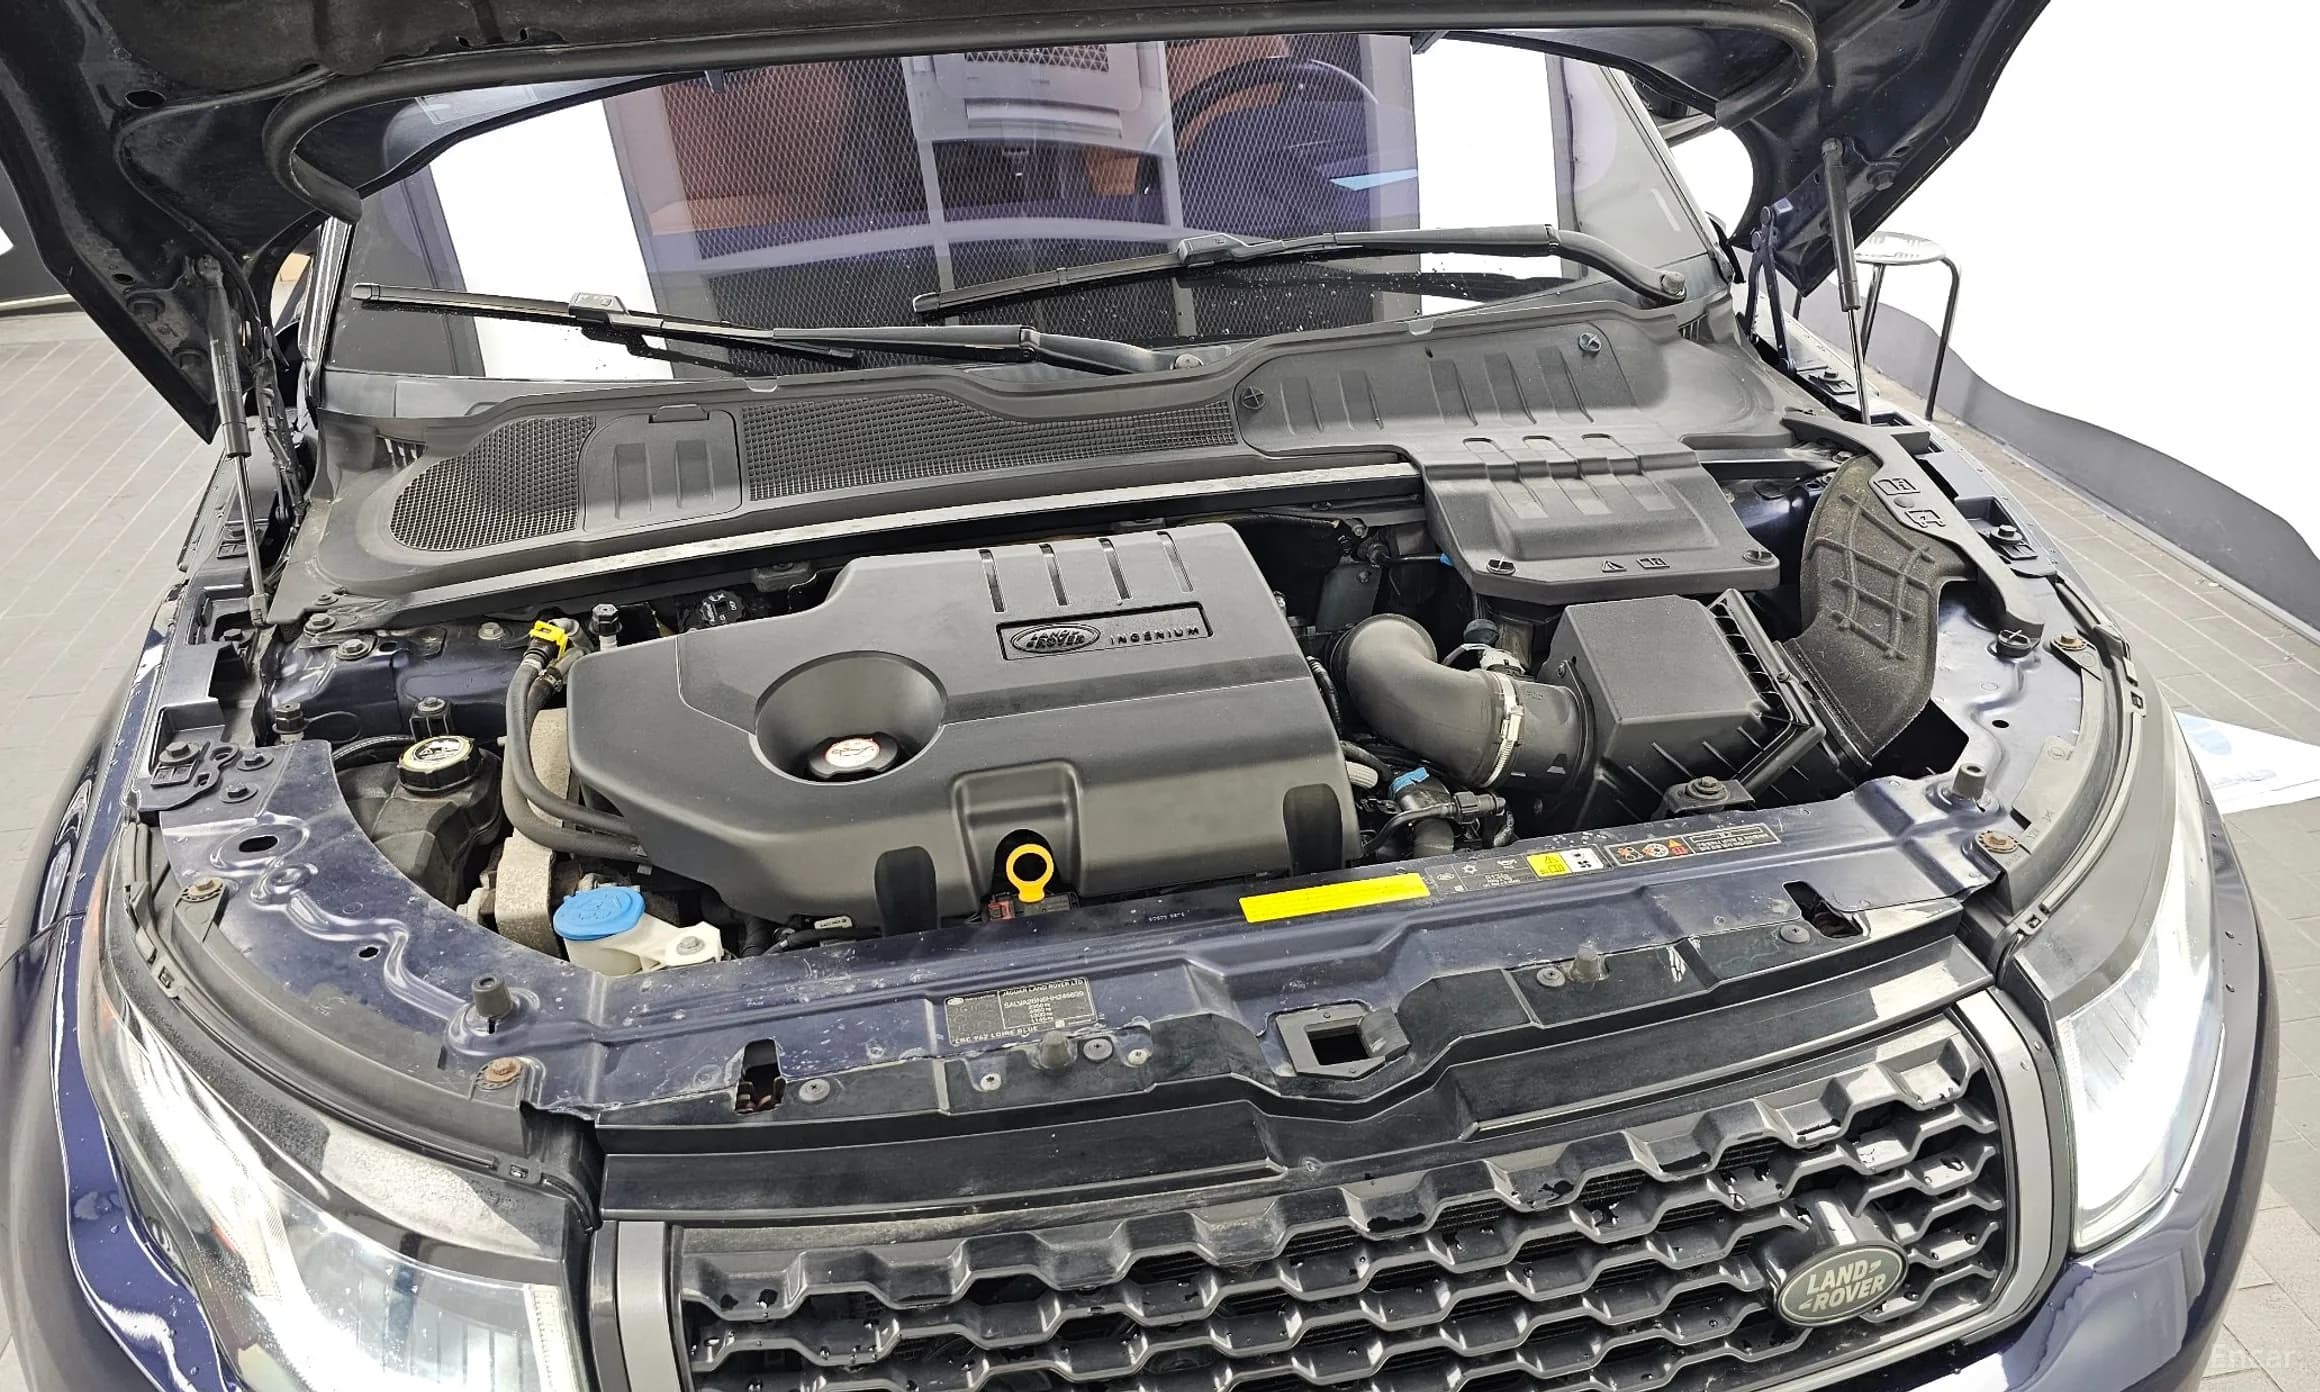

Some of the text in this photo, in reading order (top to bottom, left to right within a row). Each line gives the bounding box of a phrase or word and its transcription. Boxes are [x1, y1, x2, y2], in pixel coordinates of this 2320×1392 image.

[1034, 633, 1085, 649] ROVER
[1110, 626, 1200, 646] INGENIUM
[1029, 984, 1047, 992] LAND
[1049, 980, 1070, 989] ROVER
[1807, 1260, 1869, 1296] LAND
[1812, 1273, 1887, 1312] ROVER
